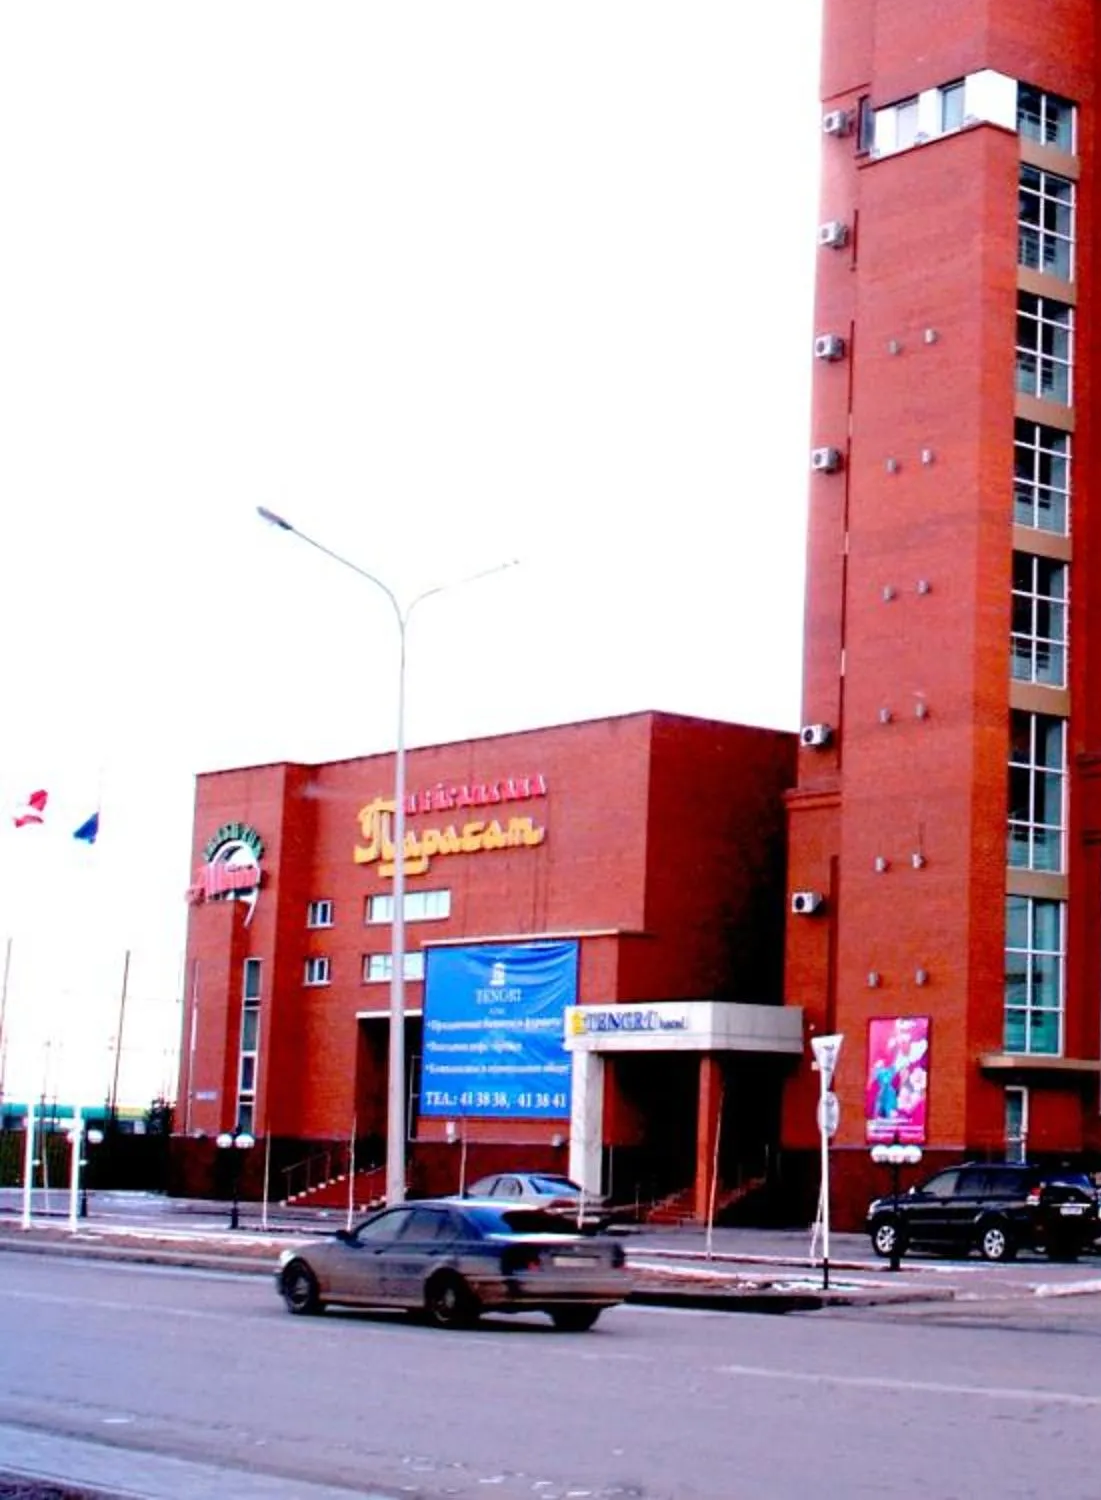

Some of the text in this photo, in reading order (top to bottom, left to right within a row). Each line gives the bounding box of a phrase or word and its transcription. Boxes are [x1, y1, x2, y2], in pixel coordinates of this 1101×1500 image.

[585, 1009, 659, 1032] TENGRI
[459, 1091, 473, 1106] 41
[517, 1093, 531, 1108] 41
[552, 1093, 567, 1108] 41
